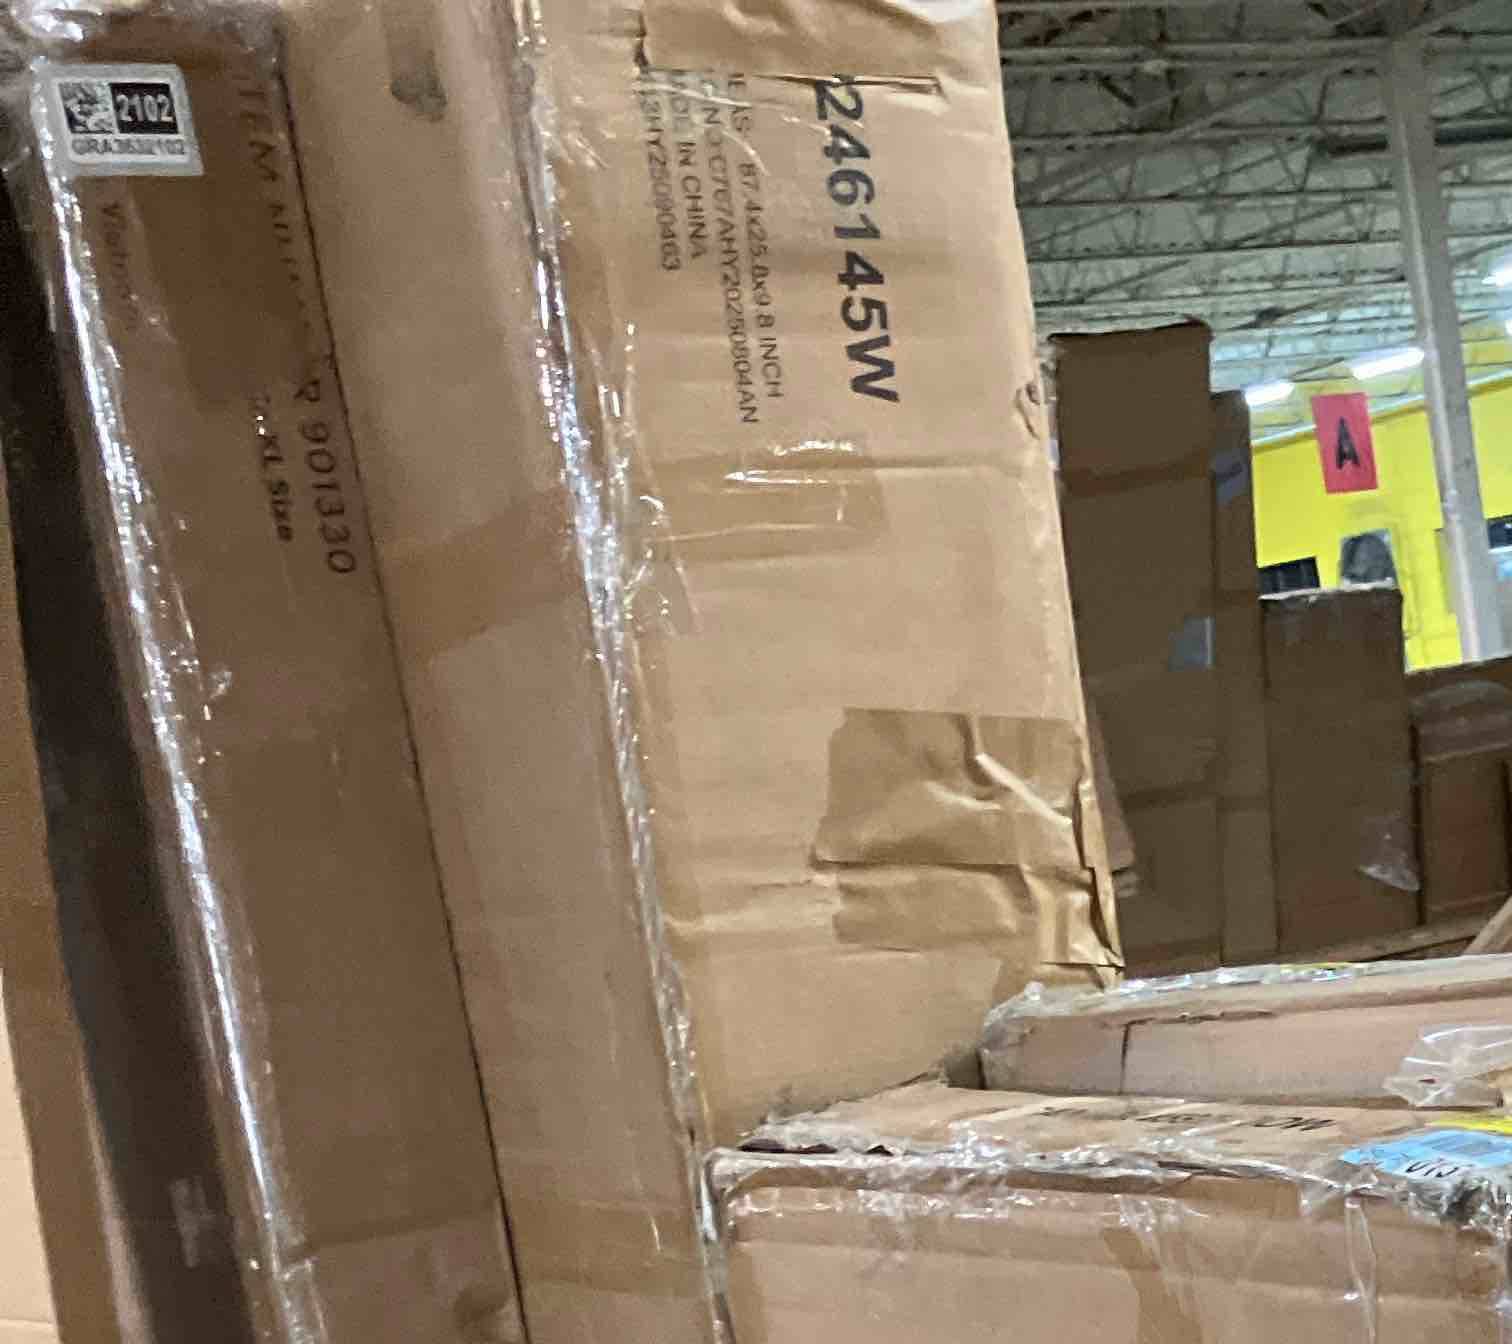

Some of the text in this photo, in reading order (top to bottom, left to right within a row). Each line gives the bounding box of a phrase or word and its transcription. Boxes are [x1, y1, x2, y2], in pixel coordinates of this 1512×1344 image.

[115, 93, 175, 123] 2102
[683, 170, 706, 262] CHINA
[814, 74, 900, 404] 246145W
[759, 333, 784, 399] INCH
[1335, 416, 1361, 470] A
